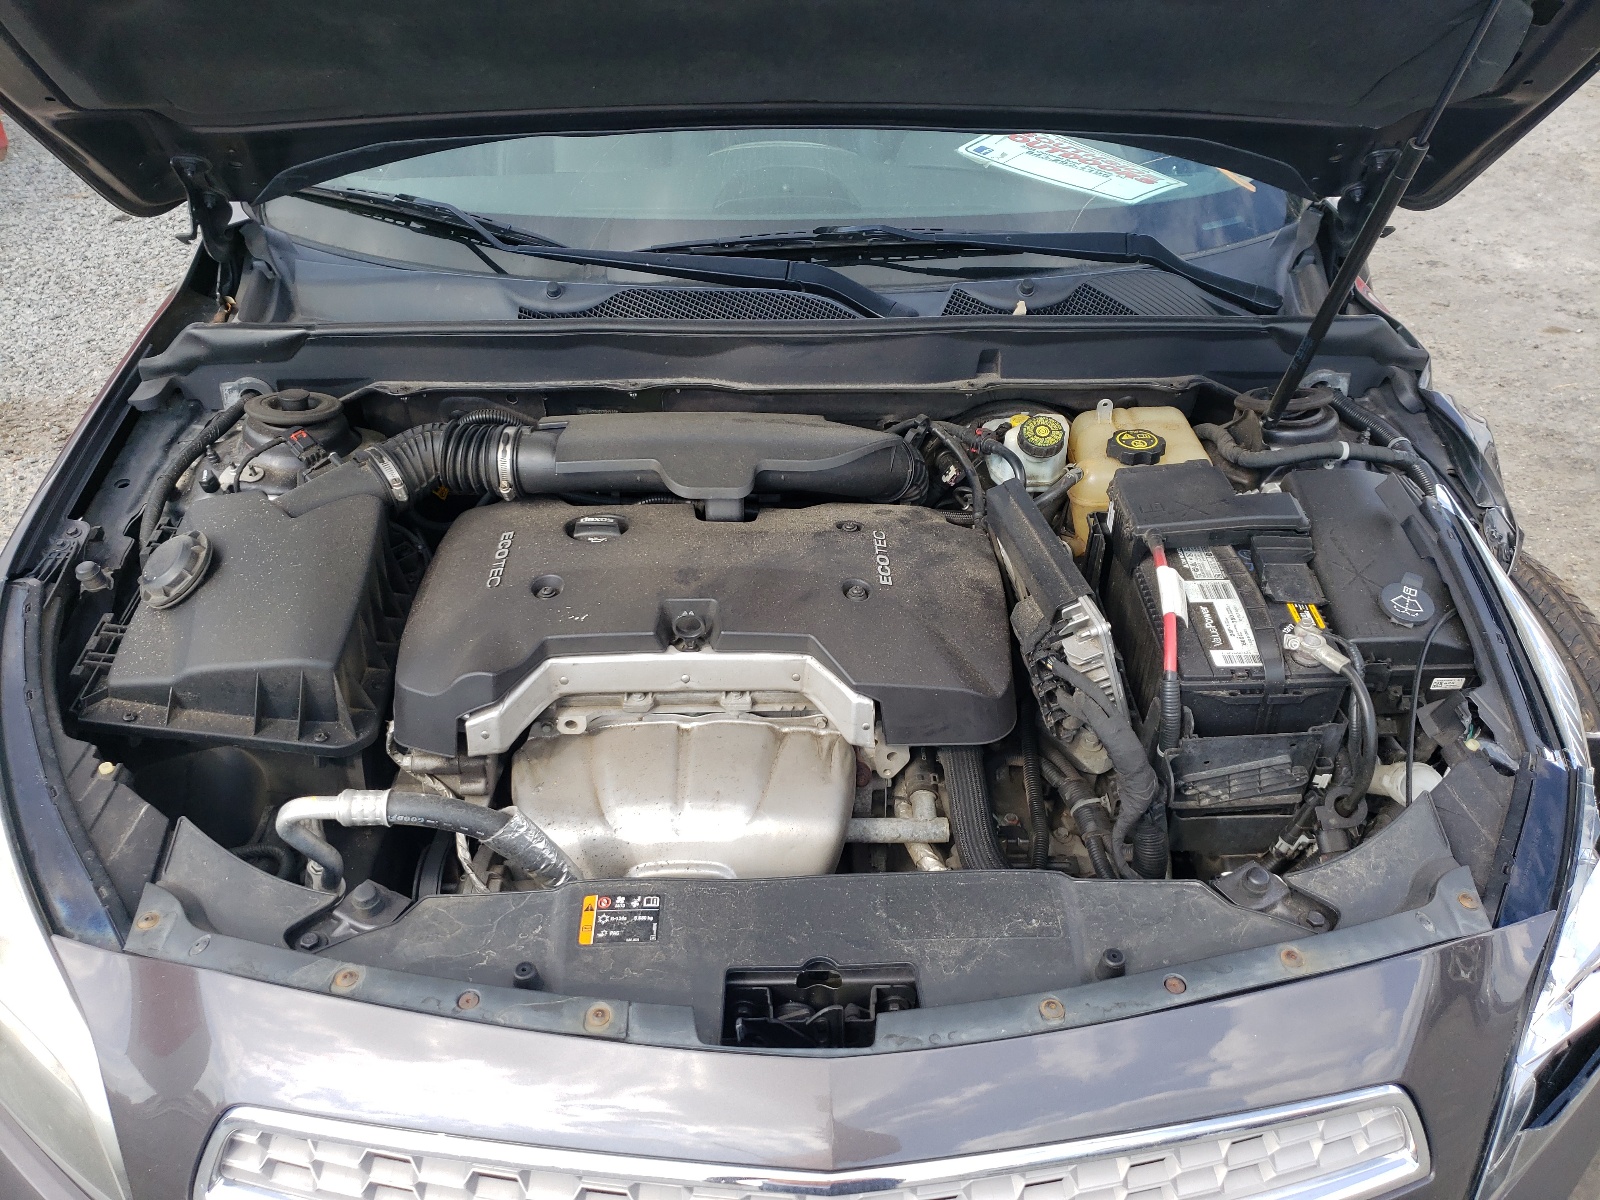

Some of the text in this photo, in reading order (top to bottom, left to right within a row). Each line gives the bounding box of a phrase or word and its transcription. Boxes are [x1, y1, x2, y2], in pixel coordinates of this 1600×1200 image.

[1008, 133, 1158, 184] OUTDOORS
[486, 531, 516, 588] ECOTEC
[873, 530, 893, 586] ECOTEC
[1199, 605, 1223, 647] ValuePower
